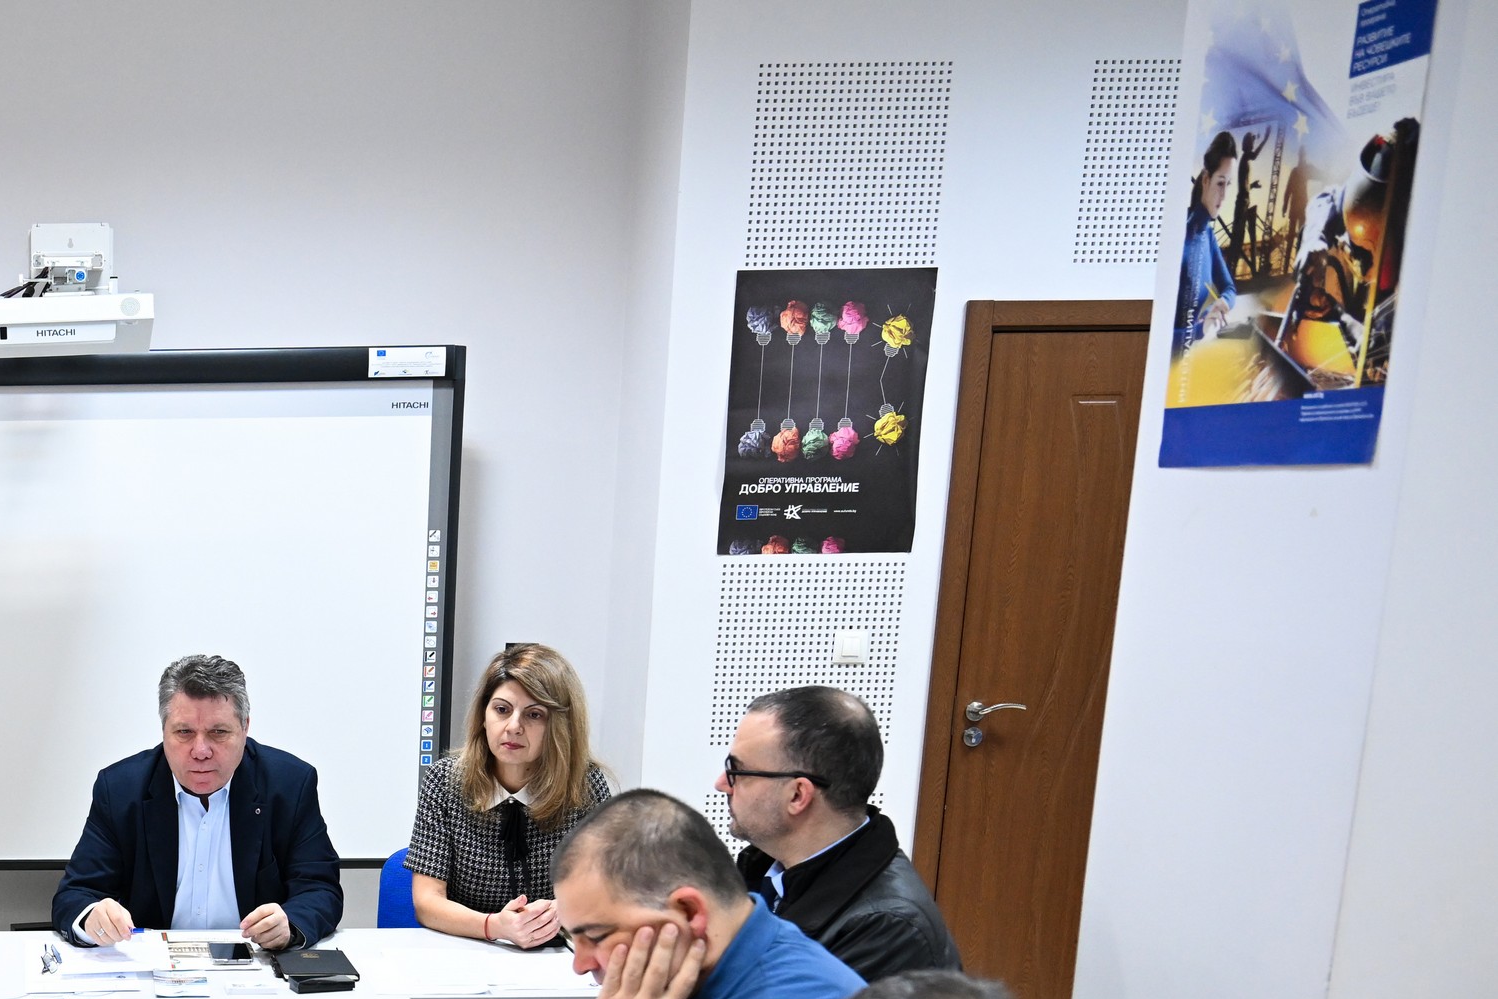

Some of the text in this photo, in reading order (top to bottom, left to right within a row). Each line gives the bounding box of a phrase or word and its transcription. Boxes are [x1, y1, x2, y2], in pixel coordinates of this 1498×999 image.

[36, 328, 76, 337] HITACHI
[391, 401, 429, 409] HITACHI
[758, 476, 843, 485] ОПЕРАТИВНА ПРОГРАМА
[739, 482, 860, 495] ДОБРО УПРАВЛЕНИЕ
